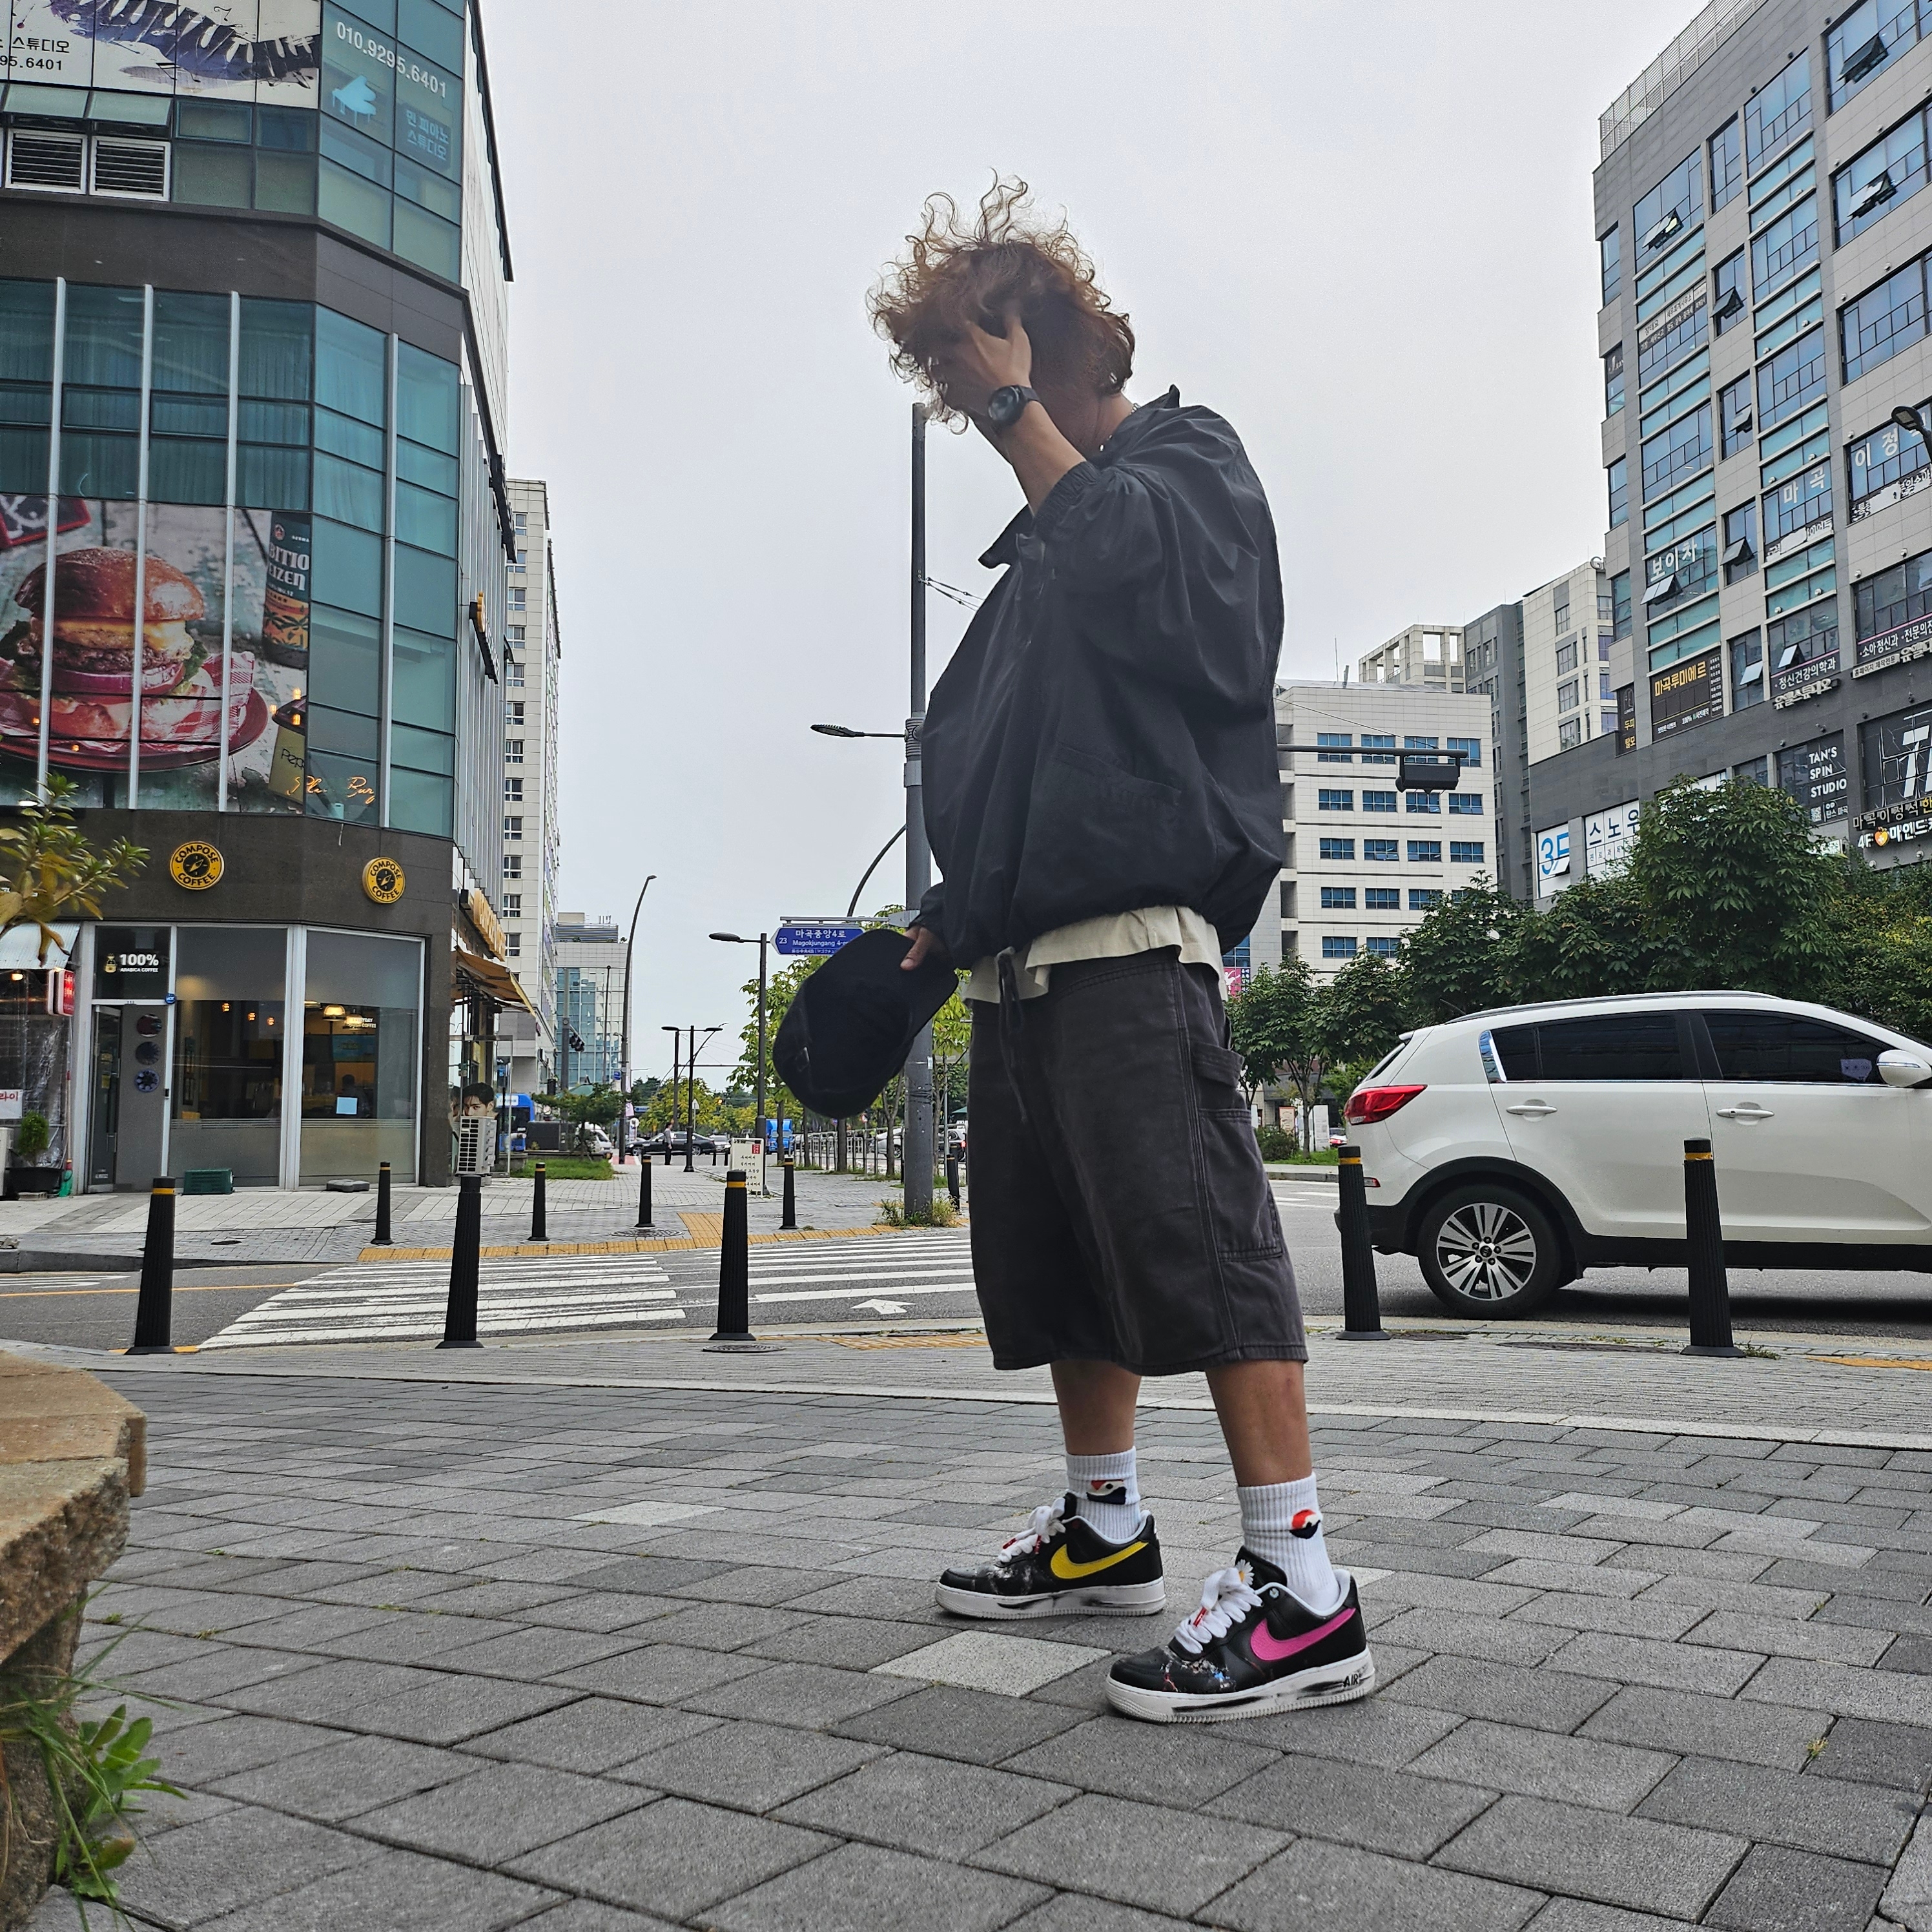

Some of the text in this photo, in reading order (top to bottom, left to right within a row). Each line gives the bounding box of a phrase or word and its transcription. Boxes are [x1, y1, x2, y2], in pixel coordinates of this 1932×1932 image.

[12, 36, 69, 53] 스튜디오
[337, 21, 446, 98] 010.9295.6401
[419, 116, 449, 144] 피아노
[407, 130, 447, 161] 스튜디오
[1783, 466, 1825, 504] 마곡
[1650, 538, 1698, 582] 보이차
[1862, 633, 1898, 657] 소아정신과
[1654, 661, 1707, 697] 마곡루미에르
[1778, 657, 1836, 690] 정신건강의학과
[1624, 717, 1635, 730] 두피
[1625, 735, 1636, 749] 탈모
[1809, 746, 1838, 765] TAN'S
[1809, 763, 1833, 780] SPIN
[1811, 778, 1847, 797] STUDIO
[1858, 833, 1873, 848] 4F
[175, 845, 219, 864] COMPOSE
[177, 872, 216, 887] COFFEE
[370, 860, 402, 880] COMPOSE
[371, 885, 400, 901] COFFEE
[796, 929, 847, 939] 마곡중앙4로
[119, 954, 159, 966] 100%
[1343, 1673, 1359, 1687] AIR
